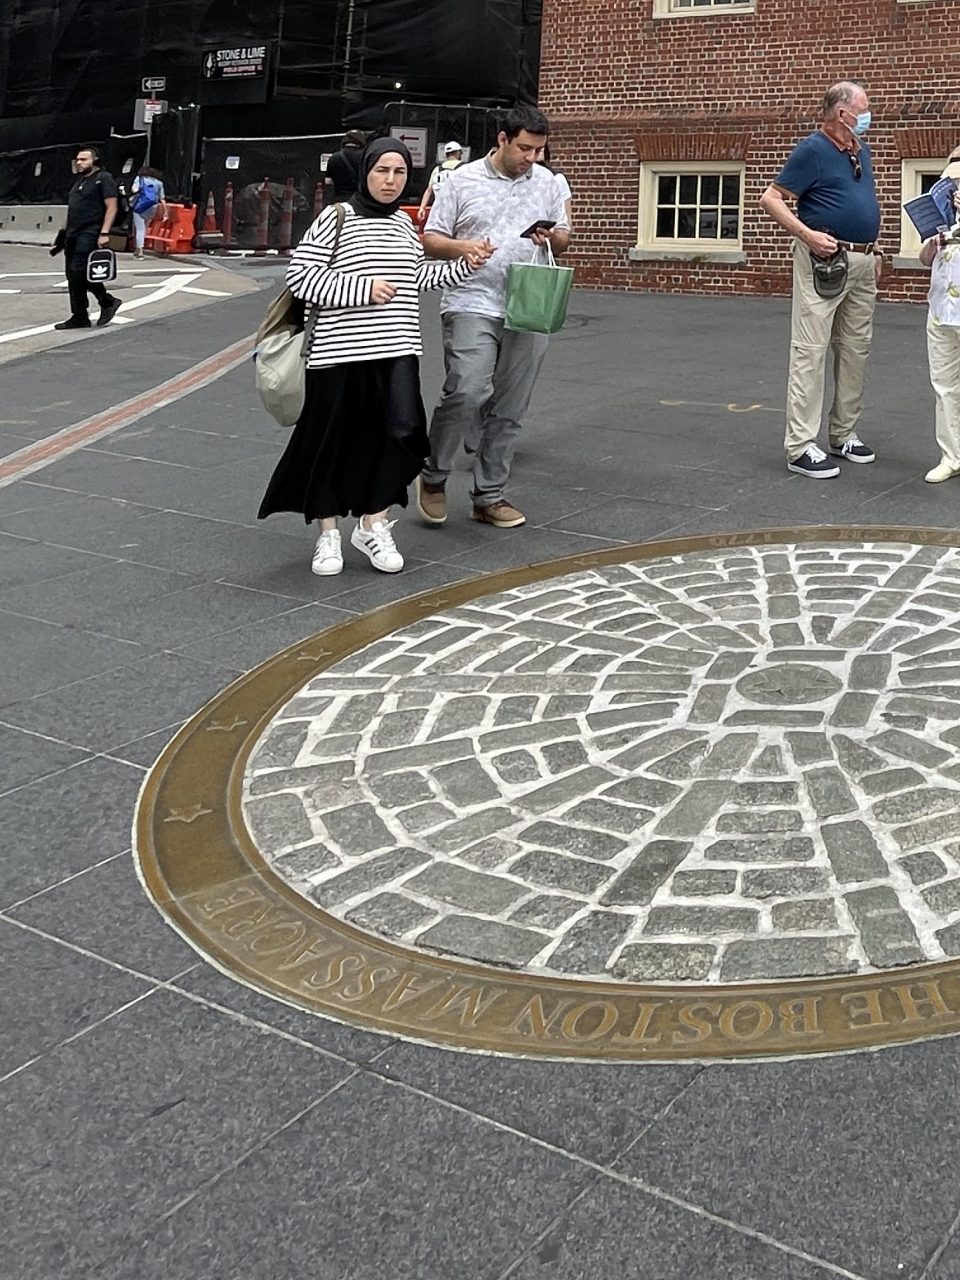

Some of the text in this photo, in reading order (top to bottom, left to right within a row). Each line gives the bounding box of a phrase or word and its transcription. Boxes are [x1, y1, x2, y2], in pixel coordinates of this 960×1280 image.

[216, 46, 266, 61] STONE & LIME
[193, 885, 506, 1028] MASSACRE
[510, 995, 823, 1044] BOSTON
